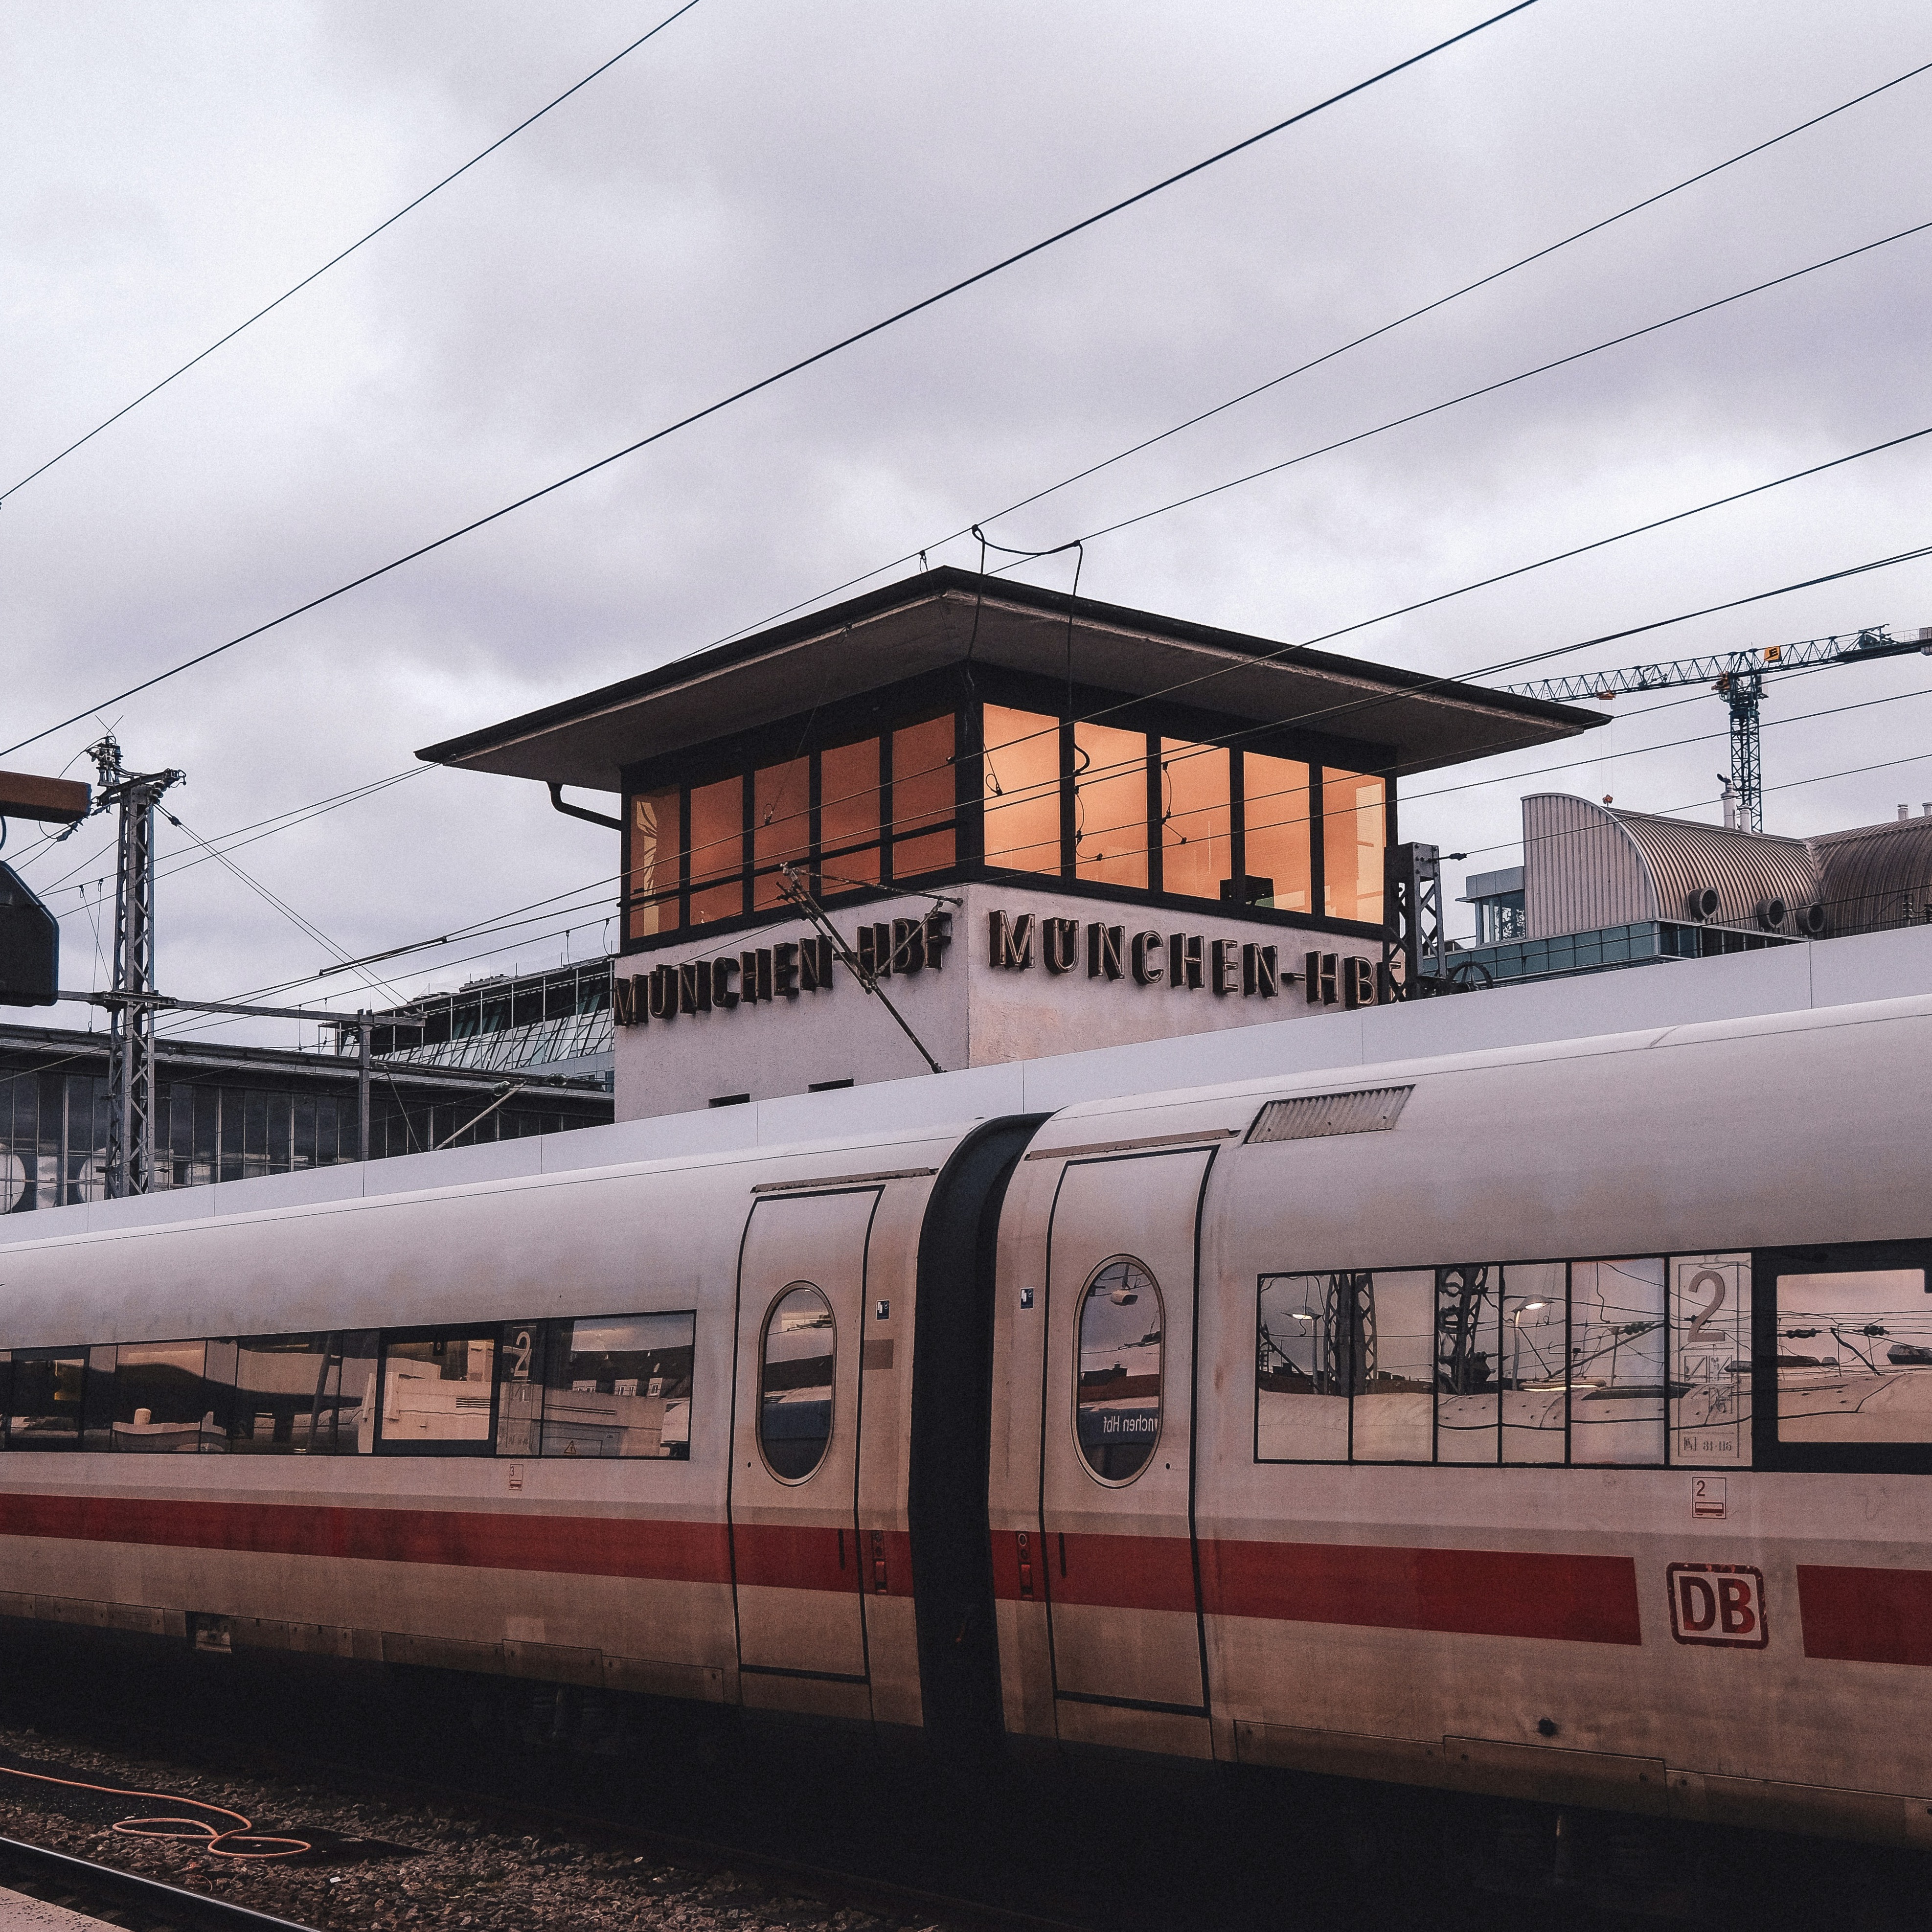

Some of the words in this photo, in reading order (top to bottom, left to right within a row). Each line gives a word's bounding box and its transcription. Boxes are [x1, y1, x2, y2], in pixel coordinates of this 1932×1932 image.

[1687, 1270, 1725, 1342] 2
[514, 1331, 530, 1376] 2
[1696, 1480, 1705, 1497] 2
[1679, 1576, 1755, 1634] DB
